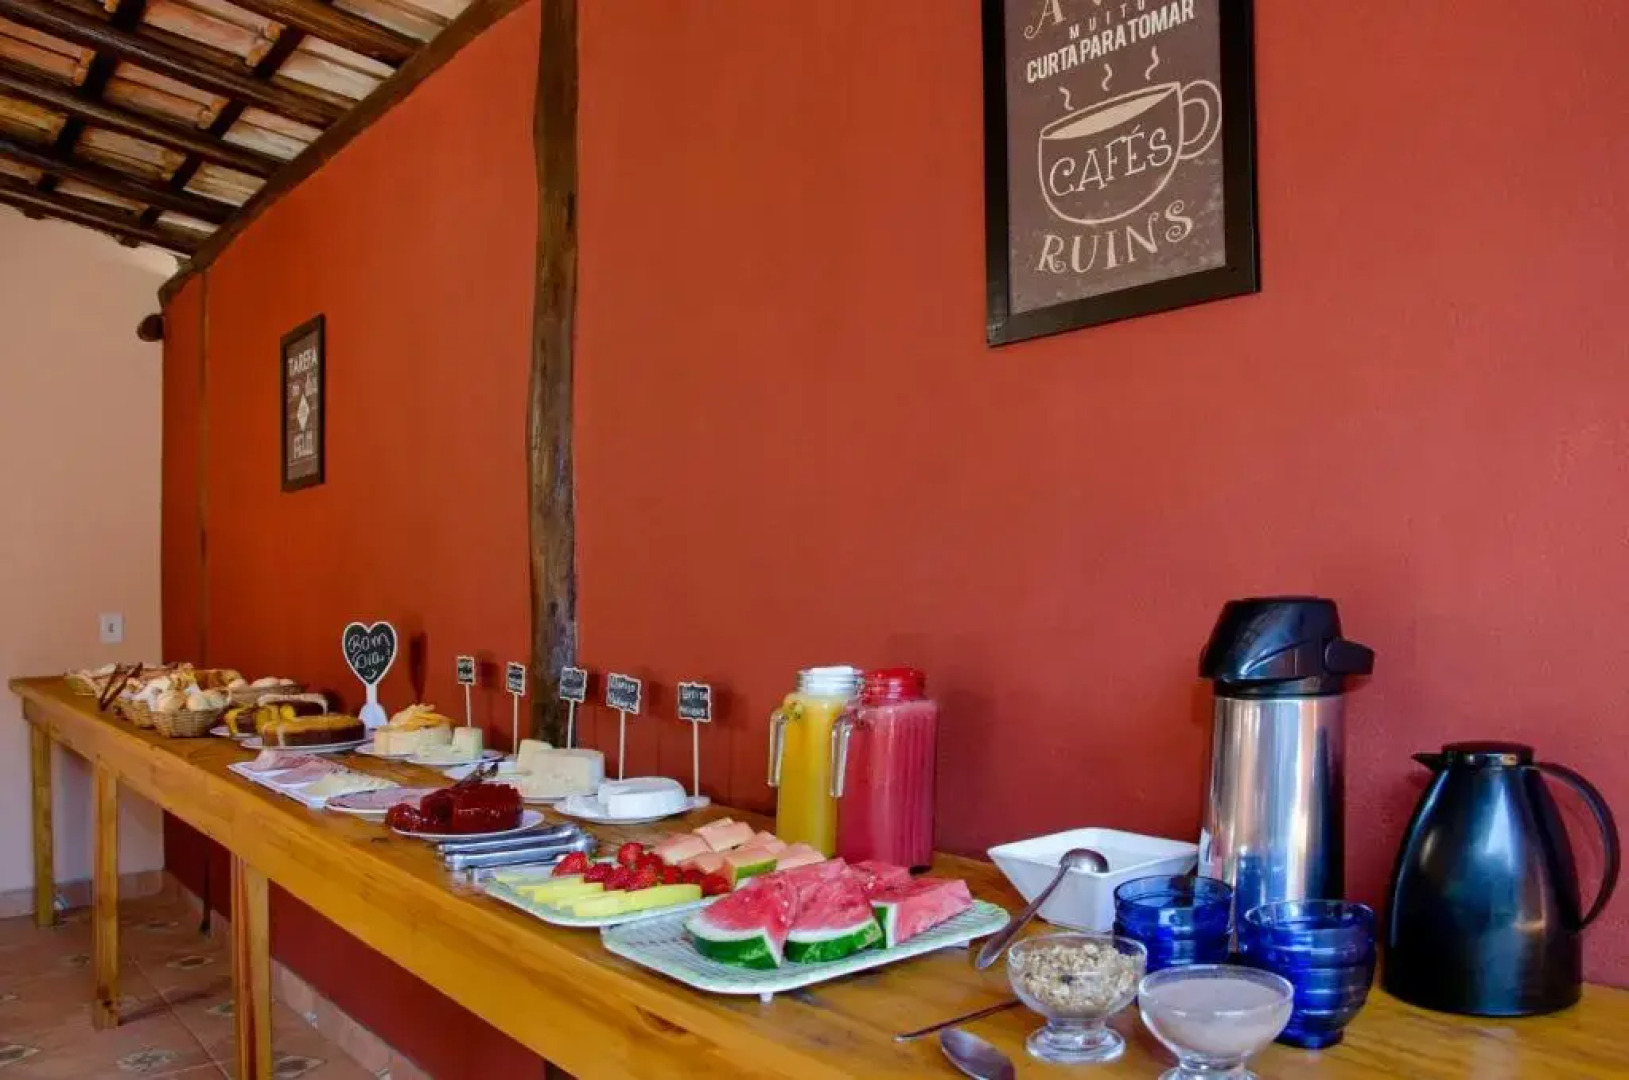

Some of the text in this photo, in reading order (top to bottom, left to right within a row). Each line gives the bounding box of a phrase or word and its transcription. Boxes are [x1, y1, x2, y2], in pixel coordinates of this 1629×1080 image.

[1027, 0, 1195, 84] CURTA PARA TOMAR
[1069, 0, 1145, 40] MUITO
[1049, 124, 1172, 197] CAFÉS
[1034, 200, 1193, 274] RUINS
